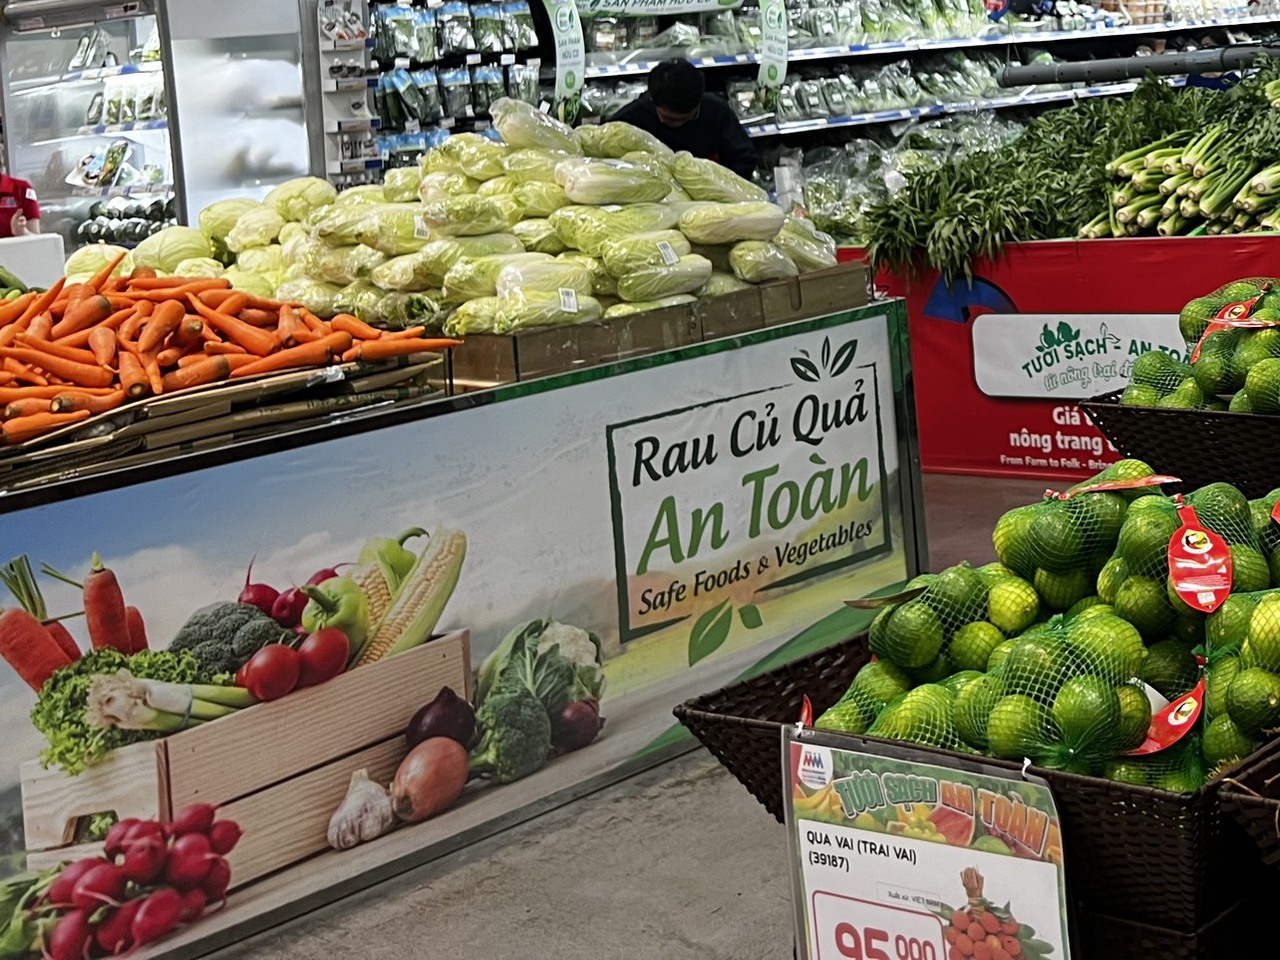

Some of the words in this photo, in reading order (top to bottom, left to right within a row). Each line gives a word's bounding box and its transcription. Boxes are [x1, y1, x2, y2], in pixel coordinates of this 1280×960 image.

[1065, 337, 1108, 362] SẠCH
[632, 433, 718, 487] Rau
[729, 402, 781, 458] Củ
[792, 378, 868, 447] Quả
[1052, 405, 1081, 426] Giá
[1009, 426, 1052, 454] nông
[1055, 430, 1103, 456] trang
[1000, 454, 1023, 466] From
[1025, 455, 1048, 467] Farm
[636, 495, 731, 576] An
[741, 452, 874, 539] Toàn
[638, 581, 687, 616] Safe
[693, 559, 751, 596] Foods
[757, 555, 770, 575] &
[774, 519, 874, 569] Vegetables
[832, 769, 887, 819] TƯƠI
[881, 771, 938, 814] SẠCH
[940, 780, 975, 817] AN
[977, 787, 1050, 858] TOÀN
[806, 829, 831, 847] QUA
[835, 835, 854, 851] VAI
[857, 840, 890, 858] (TRAI
[893, 846, 917, 865] VAI)
[808, 850, 850, 873] (39187)
[834, 921, 892, 960] 95
